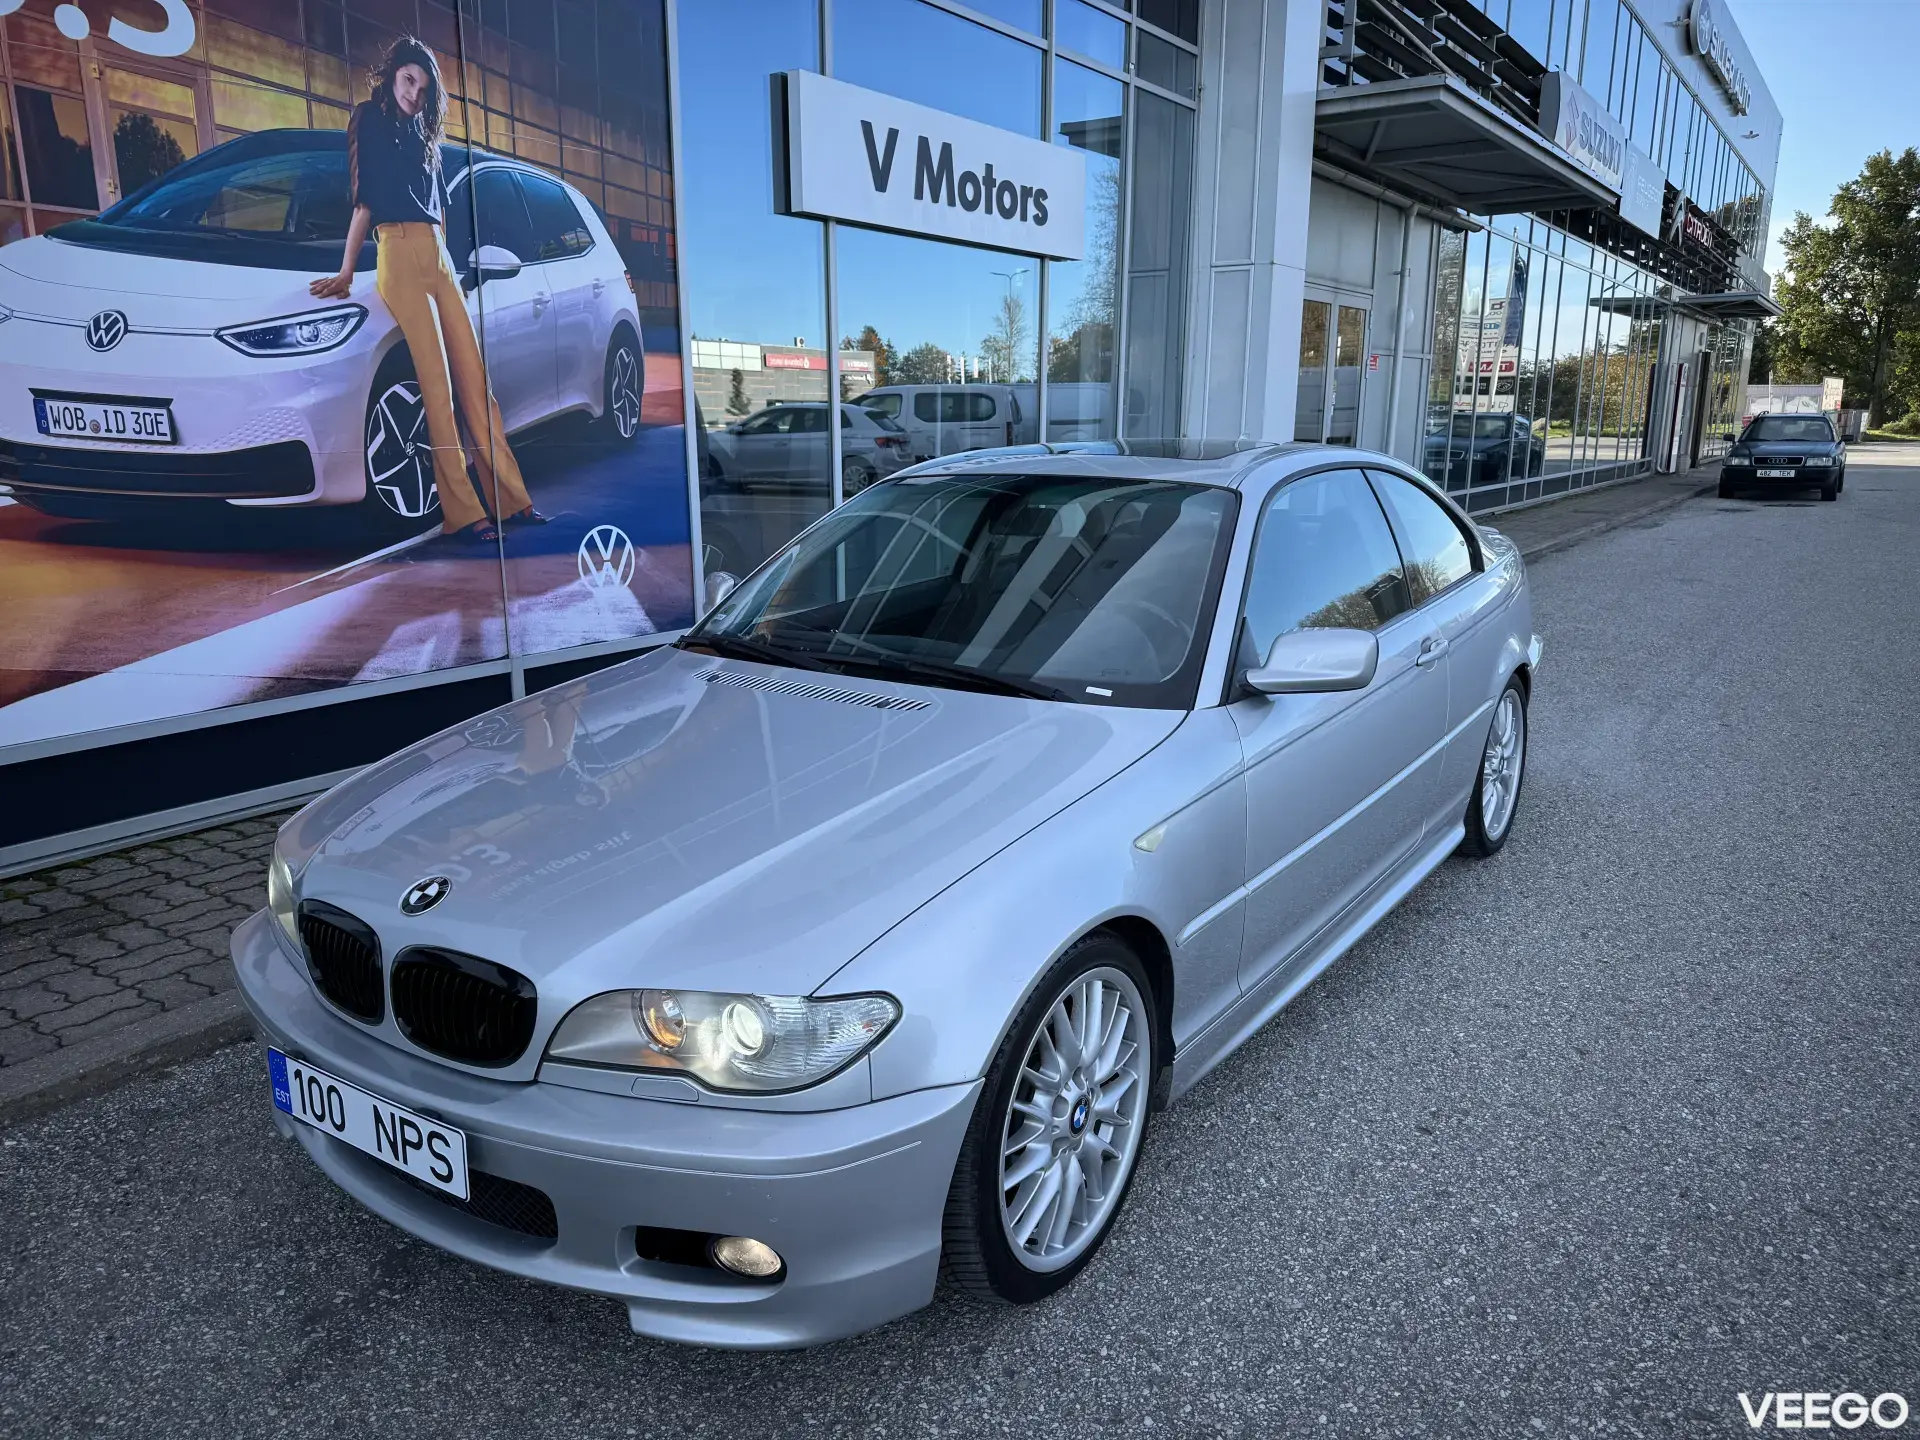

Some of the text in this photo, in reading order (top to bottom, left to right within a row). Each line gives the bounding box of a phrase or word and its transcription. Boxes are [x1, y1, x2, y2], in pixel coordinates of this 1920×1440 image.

[1734, 72, 1751, 115] AUTO
[1579, 111, 1621, 176] SUZUKI
[860, 119, 1049, 226] V Motors
[50, 405, 168, 436] WOB ID 30E
[275, 1087, 291, 1105] EST
[293, 1068, 454, 1184] 100 NPS
